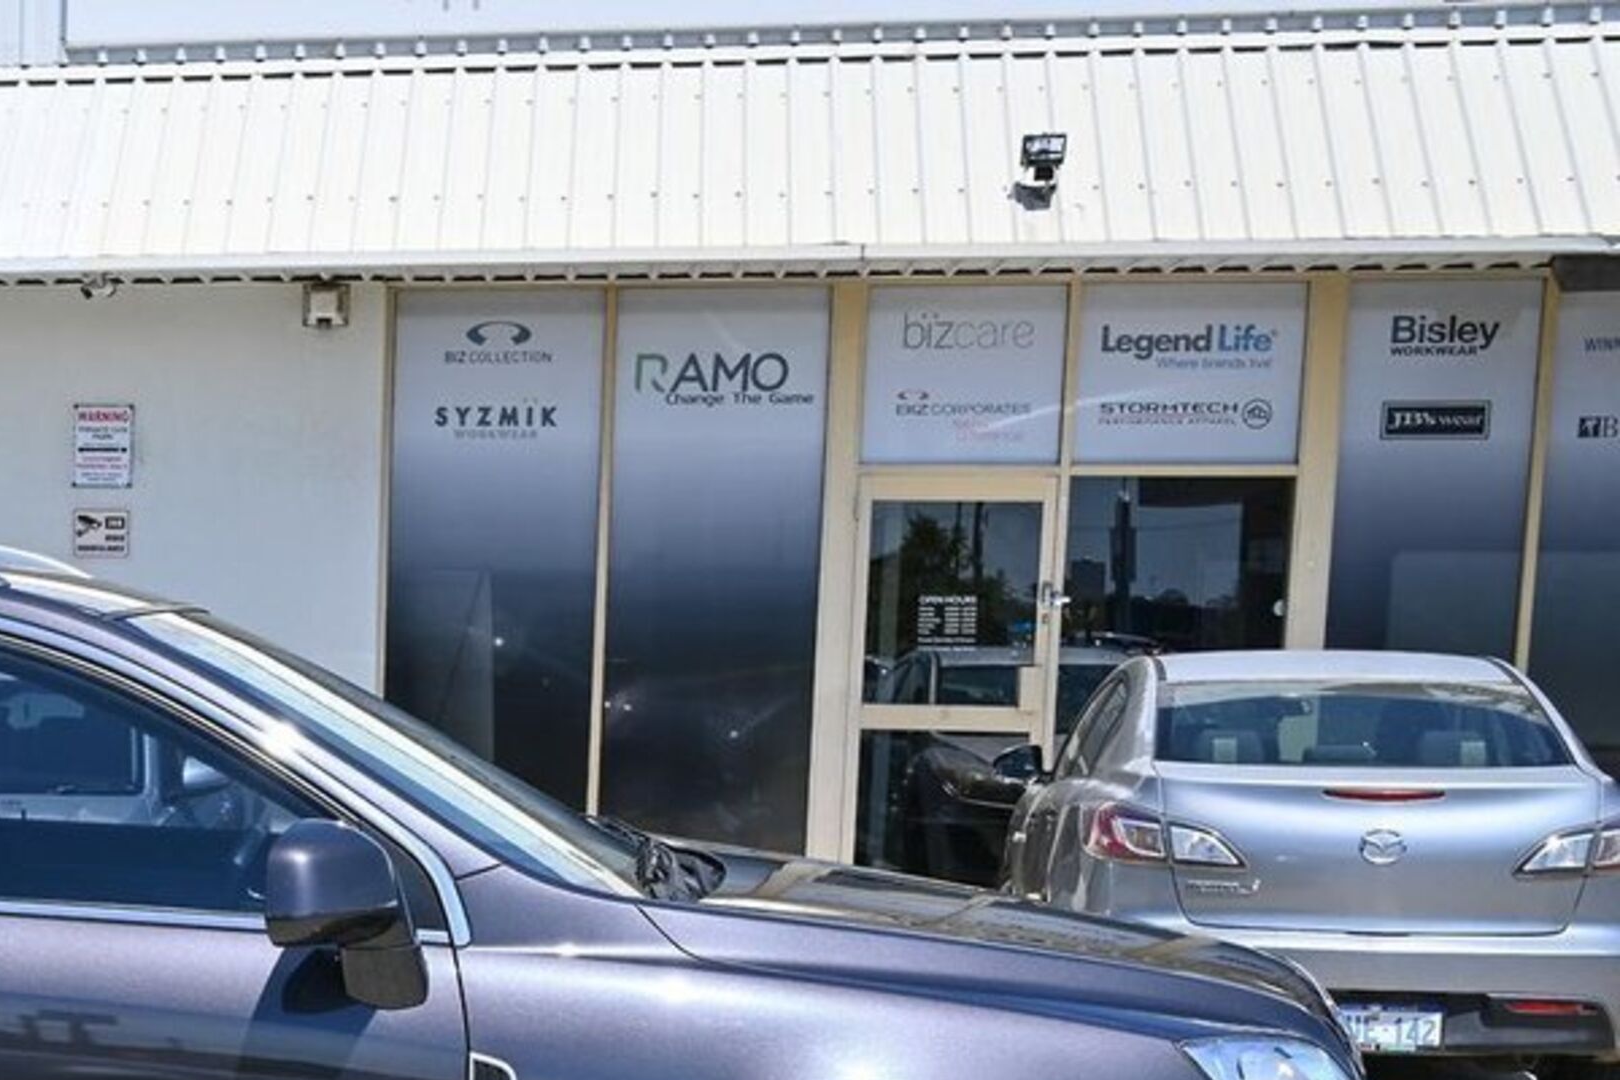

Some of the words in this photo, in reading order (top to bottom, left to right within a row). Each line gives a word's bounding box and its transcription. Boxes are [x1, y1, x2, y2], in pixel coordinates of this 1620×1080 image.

[1390, 315, 1501, 350] Bisley
[1101, 323, 1213, 361] Legend
[1219, 323, 1273, 352] Life
[469, 350, 553, 364] COLLECTION
[1390, 346, 1479, 356] WORKWEAR
[634, 352, 790, 393] RAMO
[666, 392, 725, 407] Change
[733, 393, 762, 405] The
[768, 393, 815, 405] Game
[1099, 401, 1239, 415] STORMTECH
[1438, 413, 1484, 427] wear
